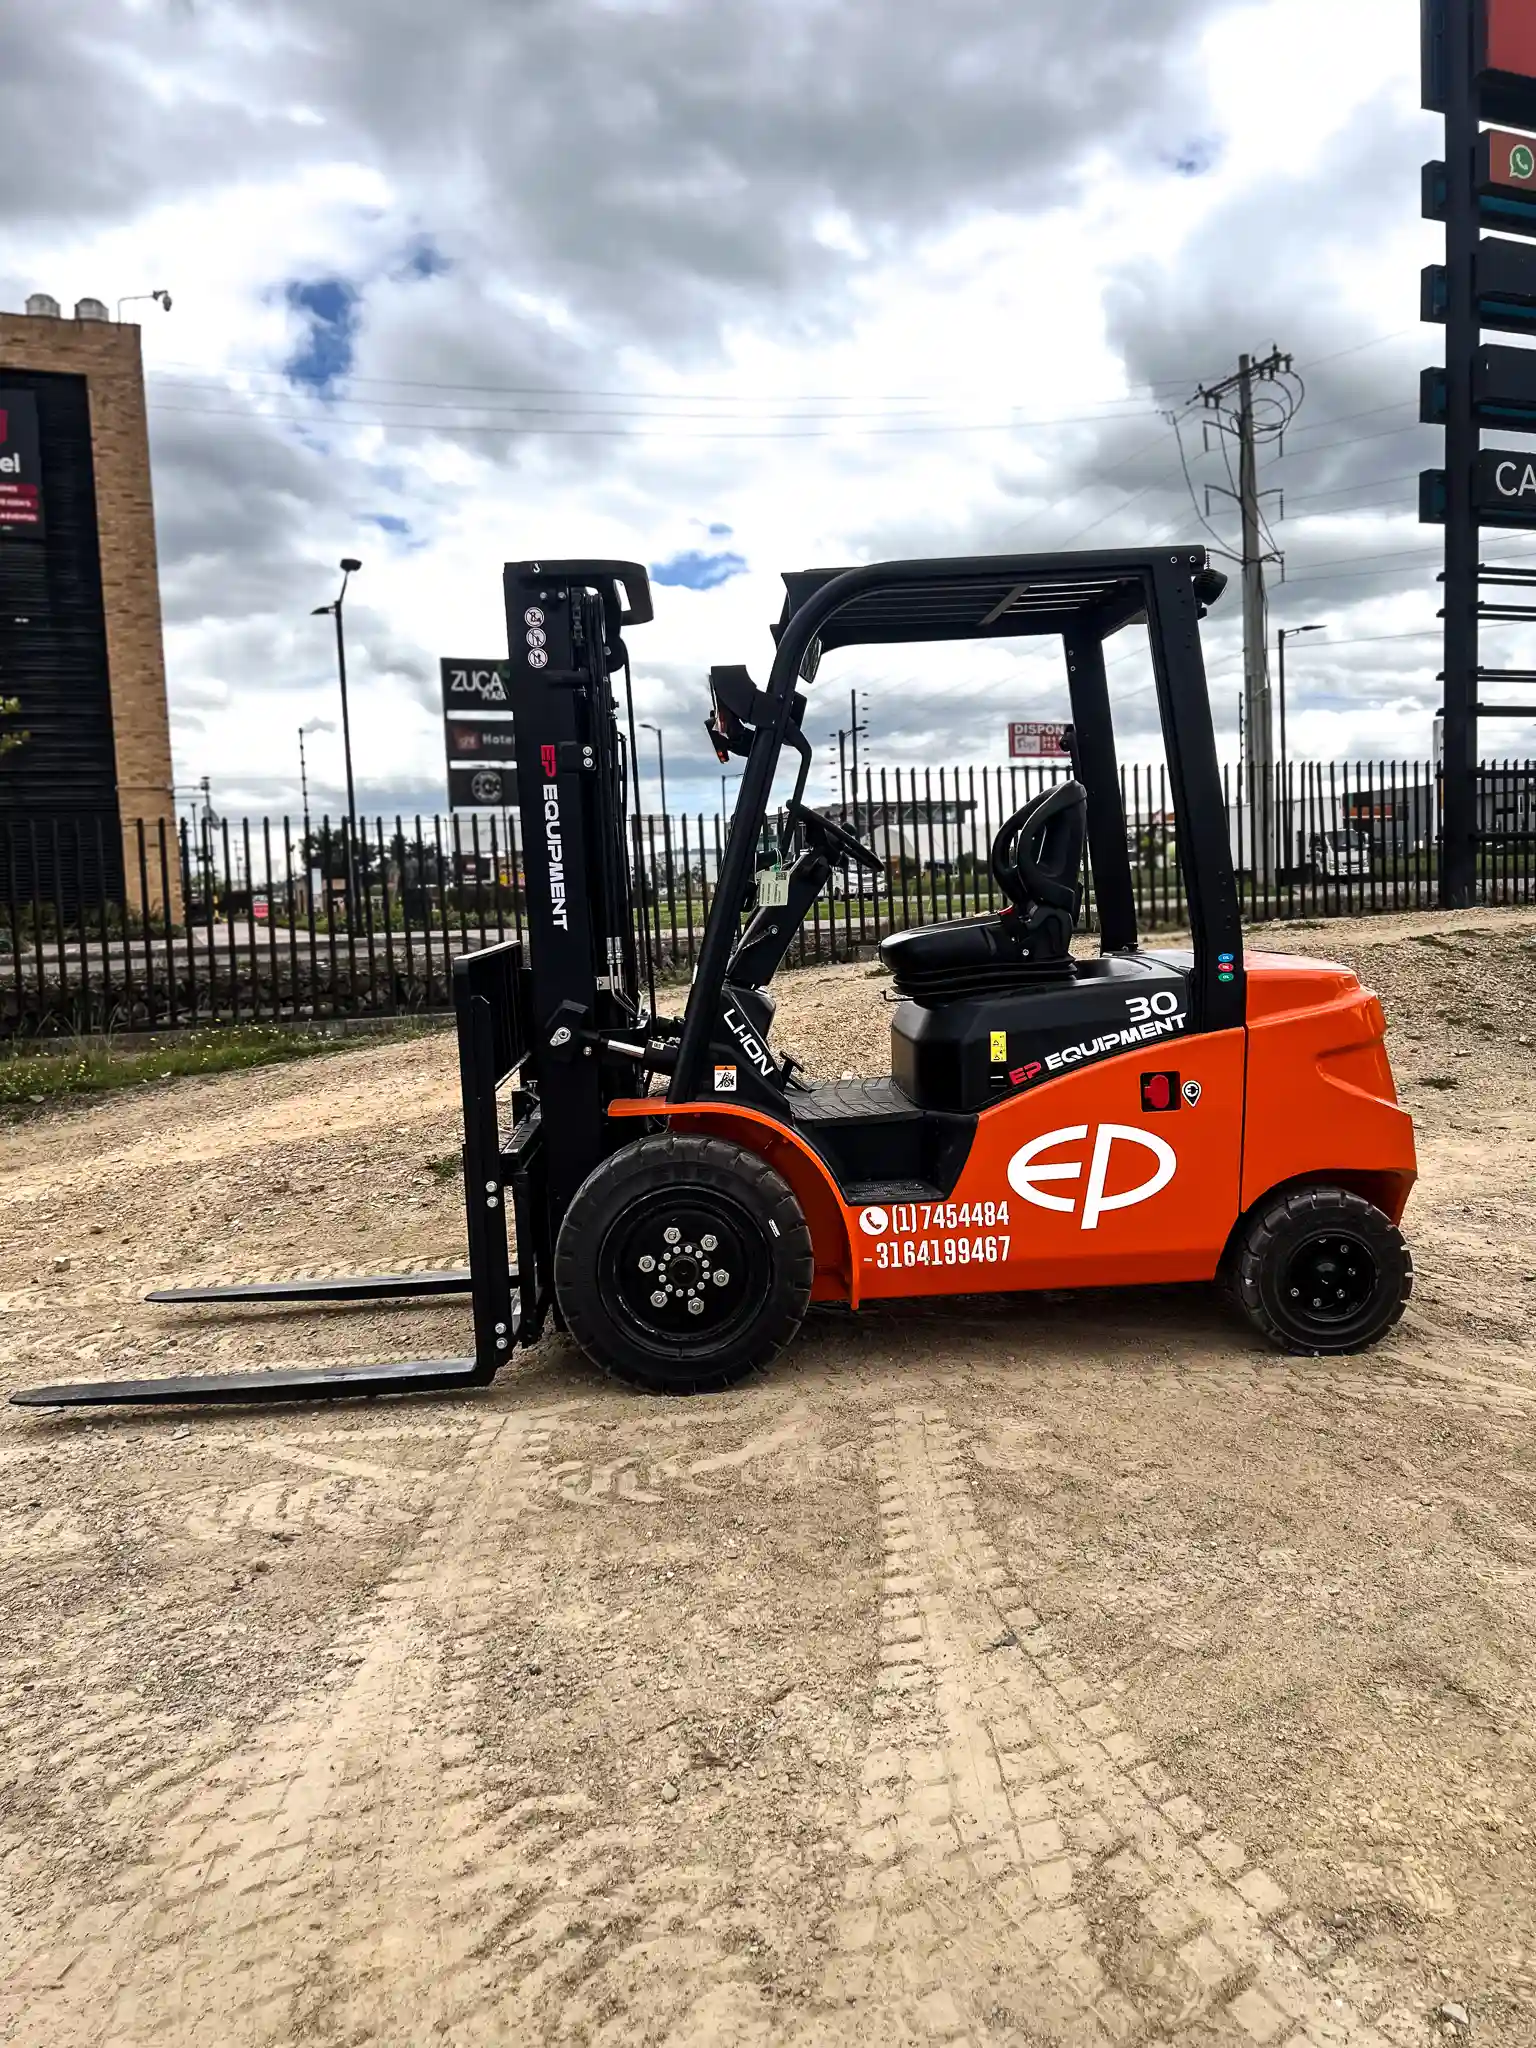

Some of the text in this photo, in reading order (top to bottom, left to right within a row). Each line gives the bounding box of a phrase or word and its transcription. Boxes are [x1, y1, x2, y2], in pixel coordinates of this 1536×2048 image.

[1495, 461, 1536, 496] CA
[542, 784, 568, 931] EQUIPMENT
[1125, 991, 1178, 1023] 30
[1008, 1012, 1187, 1086] EP EQUIPMENT
[1006, 1123, 1177, 1230] EP
